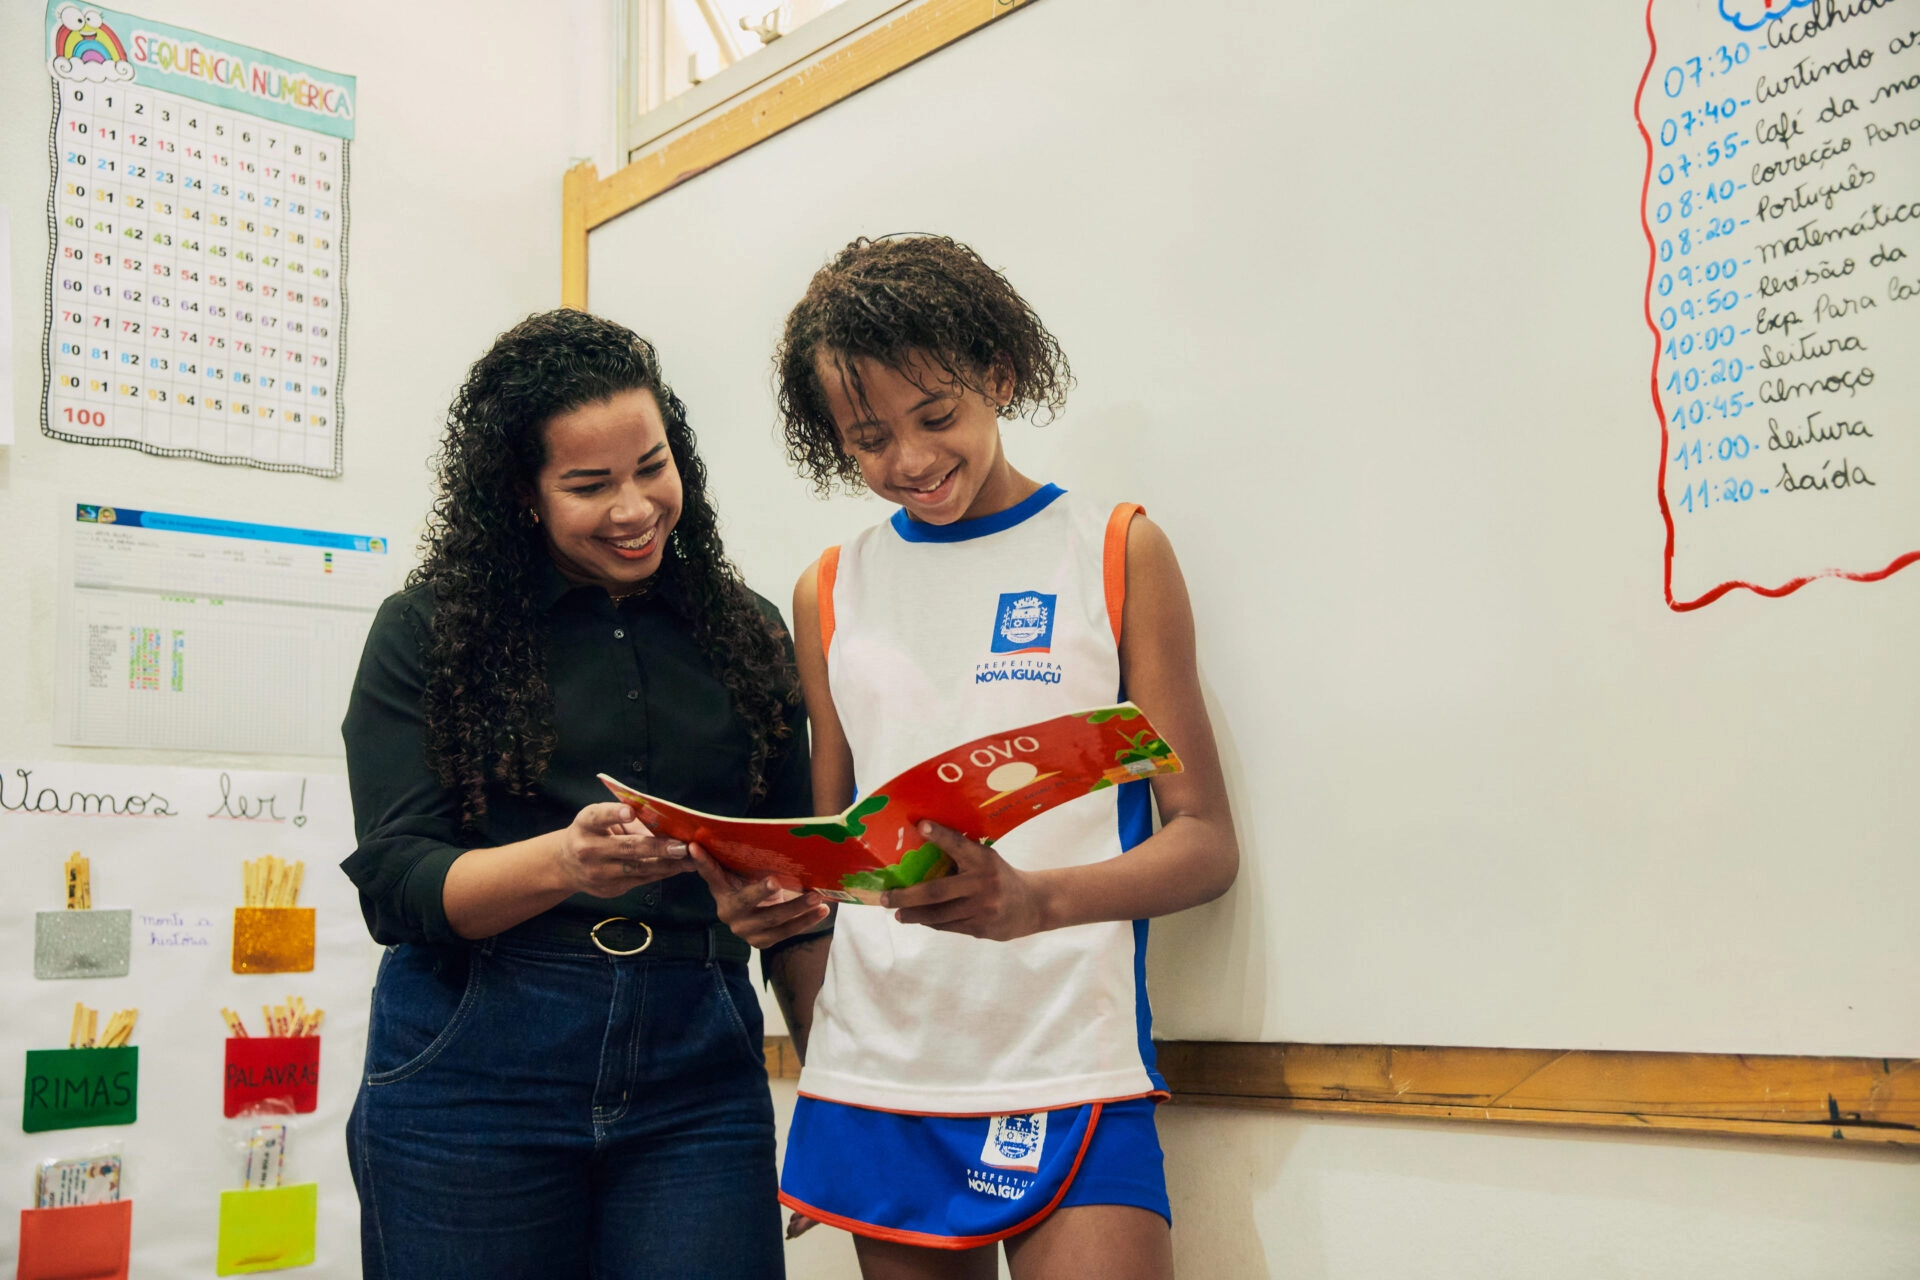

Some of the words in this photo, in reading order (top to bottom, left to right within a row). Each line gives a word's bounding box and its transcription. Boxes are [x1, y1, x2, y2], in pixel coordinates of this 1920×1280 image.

[1767, 0, 1896, 49] Acolhi
[133, 35, 246, 88] SEQUÊNCIA
[252, 69, 350, 116] NUMÉRICA
[73, 90, 84, 102] 0
[105, 97, 113, 108] 1
[134, 104, 144, 115] 2
[162, 110, 170, 122] 3
[188, 119, 198, 129] 4
[215, 126, 224, 136] 5
[242, 132, 251, 143] 6
[269, 139, 276, 149] 7
[293, 145, 302, 156] 8
[319, 152, 327, 162] 9
[1756, 108, 1804, 149] Café
[1816, 97, 1860, 124] da
[69, 122, 87, 135] 10
[99, 128, 115, 141] 11
[129, 135, 147, 148] 12
[158, 141, 174, 153] 13
[186, 149, 201, 160] 14
[213, 155, 228, 167] 15
[239, 162, 254, 173] 16
[265, 168, 280, 179] 17
[291, 174, 305, 186] 18
[317, 181, 330, 192] 19
[67, 152, 86, 166] 20
[97, 159, 114, 172] 21
[127, 166, 145, 179] 22
[156, 172, 173, 184] 23
[184, 178, 201, 190] 24
[212, 185, 228, 197] 25
[239, 193, 254, 203] 26
[264, 198, 279, 208] 27
[289, 203, 304, 215] 28
[315, 210, 330, 221] 29
[1755, 163, 1876, 223] Português
[66, 184, 85, 198] 30
[96, 190, 113, 204] 31
[126, 196, 144, 210] 32
[155, 203, 171, 215] 33
[183, 208, 199, 221] 34
[210, 215, 227, 227] 35
[239, 221, 254, 233] 36
[264, 227, 279, 238] 37
[289, 233, 304, 245] 38
[315, 239, 329, 250] 39
[64, 216, 84, 229] 40
[94, 222, 111, 235] 41
[123, 228, 143, 241] 42
[152, 234, 171, 247] 43
[181, 240, 199, 252] 44
[208, 246, 226, 258] 45
[235, 251, 253, 263] 46
[261, 256, 278, 268] 47
[287, 263, 303, 273] 48
[312, 268, 328, 279] 49
[1869, 243, 1907, 267] da
[64, 248, 83, 261] 50
[93, 253, 111, 266] 51
[123, 259, 141, 272] 52
[153, 264, 170, 278] 53
[181, 270, 198, 283] 54
[209, 276, 226, 288] 55
[236, 281, 253, 293] 56
[262, 286, 277, 298] 57
[287, 292, 303, 304] 58
[312, 297, 328, 308] 59
[63, 280, 82, 293] 60
[93, 286, 110, 297] 61
[123, 291, 141, 303] 62
[151, 296, 169, 308] 63
[180, 302, 198, 313] 64
[209, 307, 225, 318] 65
[236, 312, 252, 323] 66
[261, 318, 277, 328] 67
[287, 323, 302, 333] 68
[312, 328, 327, 338] 69
[63, 312, 82, 324] 70
[93, 316, 110, 329] 71
[122, 321, 140, 334] 72
[151, 327, 169, 339] 73
[182, 332, 197, 344] 74
[209, 337, 224, 349] 75
[237, 342, 251, 353] 76
[262, 347, 276, 358] 77
[287, 352, 302, 363] 78
[313, 357, 327, 367] 79
[1758, 331, 1868, 370] Leitura
[61, 343, 80, 356] 80
[91, 349, 108, 361] 81
[121, 353, 139, 366] 82
[150, 359, 168, 371] 83
[178, 363, 196, 375] 84
[206, 368, 223, 380] 85
[233, 372, 250, 384] 86
[260, 378, 275, 388] 87
[285, 382, 301, 393] 88
[311, 387, 327, 397] 89
[59, 376, 80, 389] 90
[89, 380, 107, 393] 91
[119, 384, 138, 398] 92
[147, 390, 166, 402] 93
[177, 394, 195, 406] 94
[204, 399, 222, 411] 95
[231, 403, 249, 415] 96
[258, 408, 274, 419] 97
[284, 412, 300, 423] 98
[310, 416, 326, 427] 99
[63, 407, 106, 427] 100
[1767, 410, 1874, 451] Leitura
[975, 669, 1010, 684] NOVA
[1011, 668, 1062, 685] IGUAÇU
[976, 660, 1062, 672] PREFEITURA
[937, 763, 964, 783] O
[969, 736, 1040, 768] OVO
[0, 768, 178, 816] Vamos
[29, 1071, 132, 1110] RIMAS
[967, 1177, 998, 1197] NOVA
